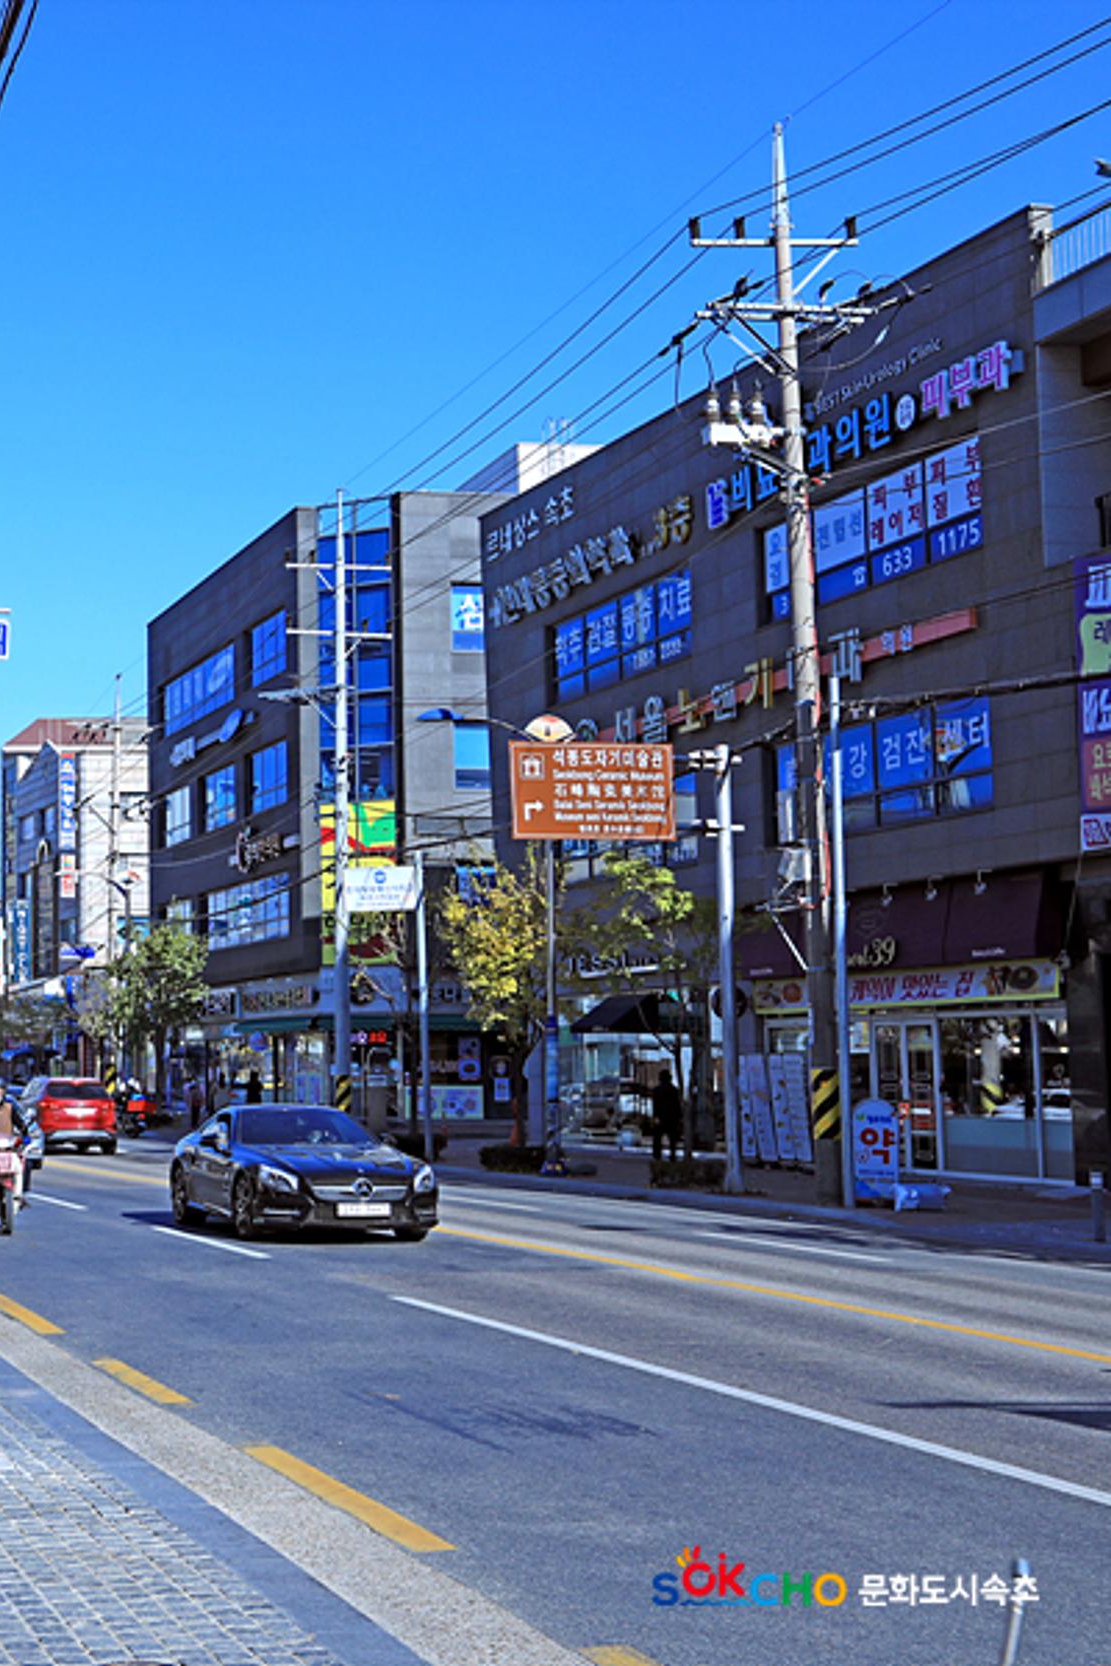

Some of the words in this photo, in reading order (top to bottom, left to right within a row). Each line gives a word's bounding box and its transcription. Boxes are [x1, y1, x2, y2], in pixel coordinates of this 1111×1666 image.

[919, 340, 1014, 418] 피부과
[882, 546, 913, 577] 633
[938, 517, 981, 557] 1175
[658, 577, 691, 621] 치료
[882, 725, 929, 771] 검진
[859, 1126, 897, 1166] 약
